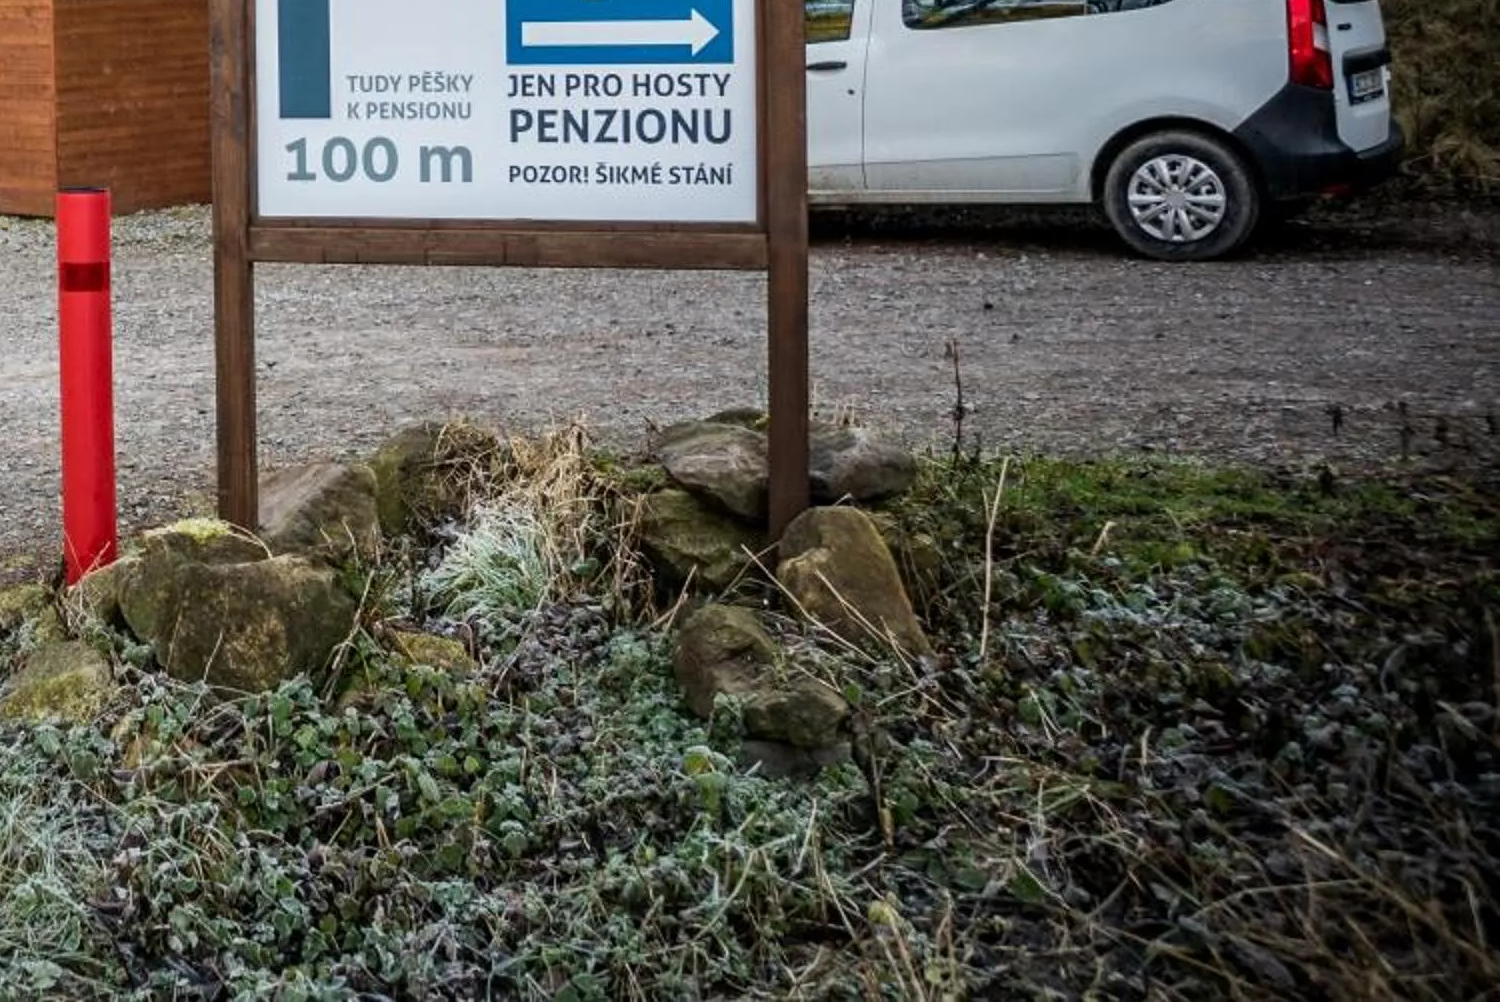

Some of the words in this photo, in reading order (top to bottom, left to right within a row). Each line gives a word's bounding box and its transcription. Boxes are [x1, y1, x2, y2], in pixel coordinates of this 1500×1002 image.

[346, 74, 402, 93] TUDY
[408, 70, 474, 93] PĚŠKY
[507, 74, 555, 98] JEN
[565, 72, 623, 98] PRO
[632, 73, 731, 97] HOSTY
[347, 101, 361, 120] K
[366, 101, 472, 120] PENSIONU
[510, 108, 732, 145] PENZIONU
[285, 136, 399, 183] 100
[419, 145, 473, 183] m
[509, 165, 589, 184] POZOR!
[595, 162, 663, 185] ŠIKMÉ
[669, 162, 733, 185] STÁNÍ
